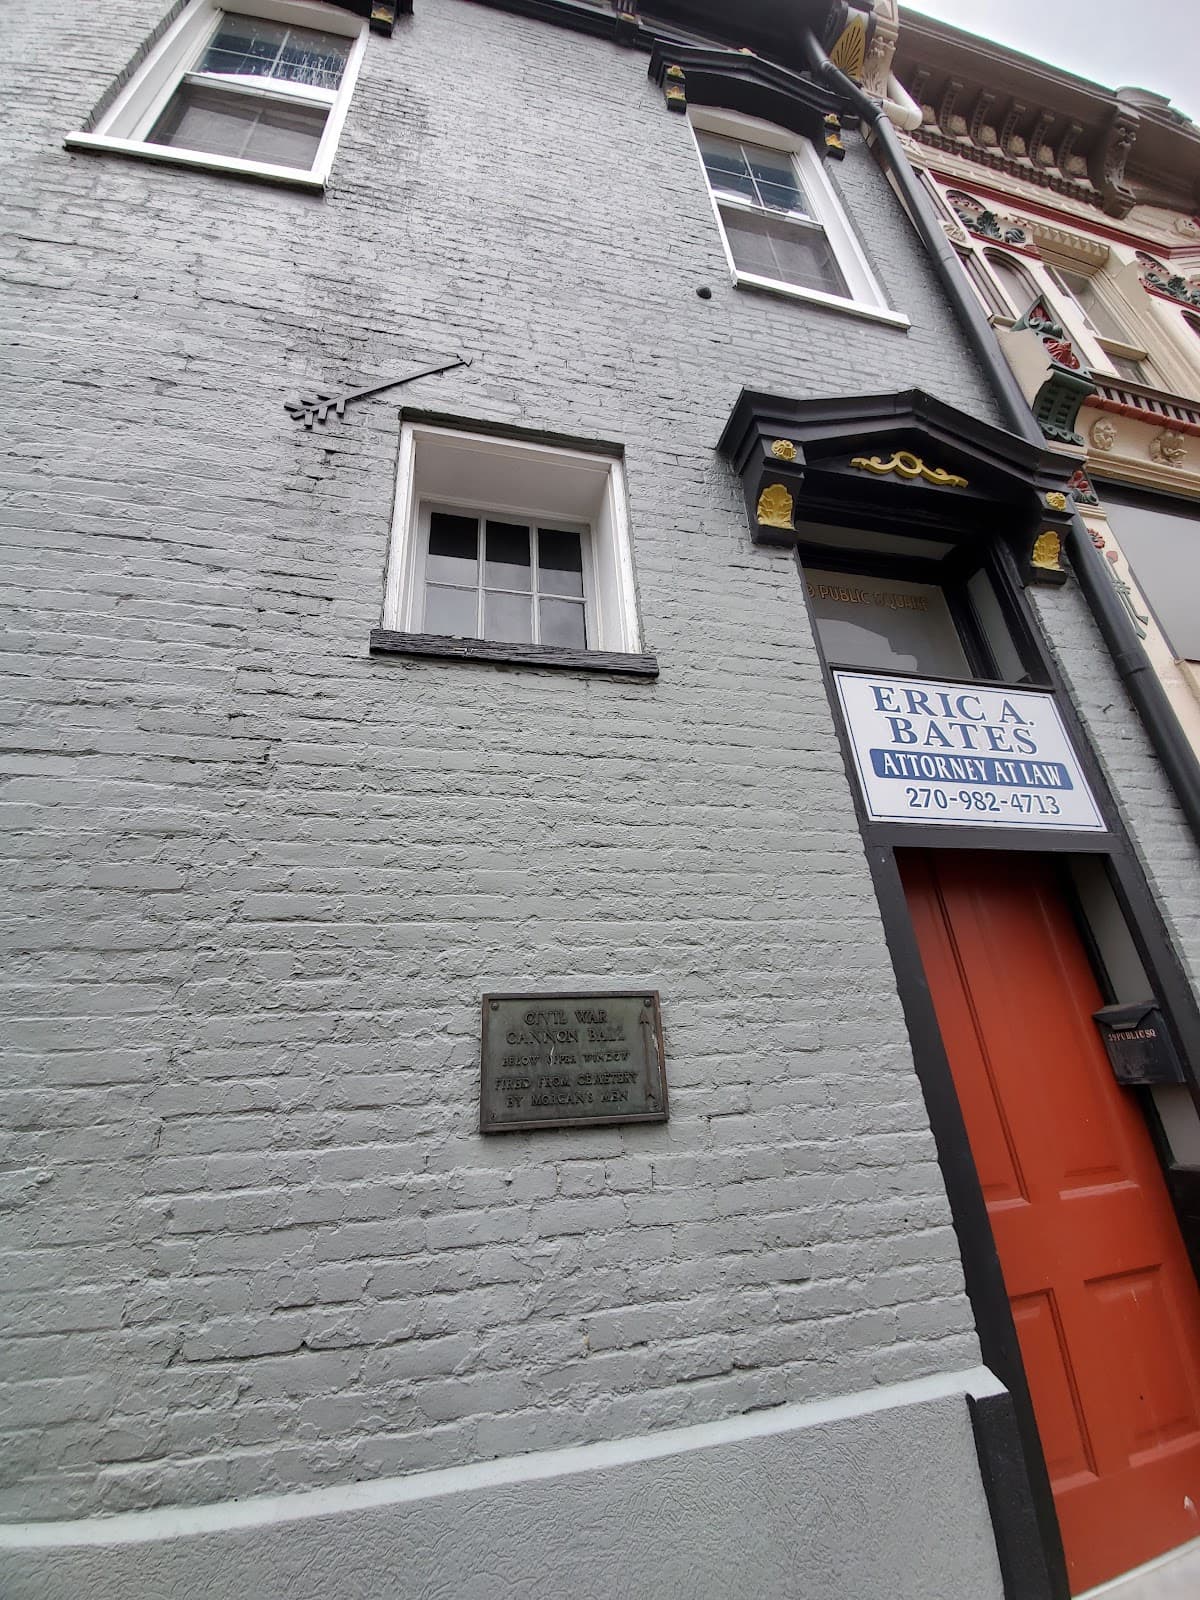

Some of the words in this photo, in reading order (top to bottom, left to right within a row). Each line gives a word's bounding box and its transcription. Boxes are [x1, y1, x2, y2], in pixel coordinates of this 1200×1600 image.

[818, 584, 870, 605] PUBLIC
[869, 685, 985, 722] ERIC
[999, 699, 1034, 726] A.
[885, 716, 1038, 755] BATES
[883, 752, 987, 783] ATTORNEY
[995, 764, 1020, 784] AT
[1020, 765, 1062, 787] LAW
[906, 787, 1060, 815] 270-982-4713
[524, 1009, 568, 1026] CIVIL
[575, 1009, 608, 1024] WAR
[506, 1029, 579, 1045] CANNON
[588, 1026, 625, 1042] BALL
[1116, 1030, 1145, 1041] PUBLIC
[1145, 1028, 1156, 1038] SQ
[503, 1055, 540, 1067] BELOW
[544, 1055, 576, 1066] UPPER
[583, 1052, 630, 1063] WINDOW
[496, 1077, 531, 1090] FIRED
[538, 1076, 571, 1089] FROM
[577, 1072, 639, 1086] CEMETERY
[506, 1095, 525, 1108] BY
[601, 1090, 628, 1103] MEN
